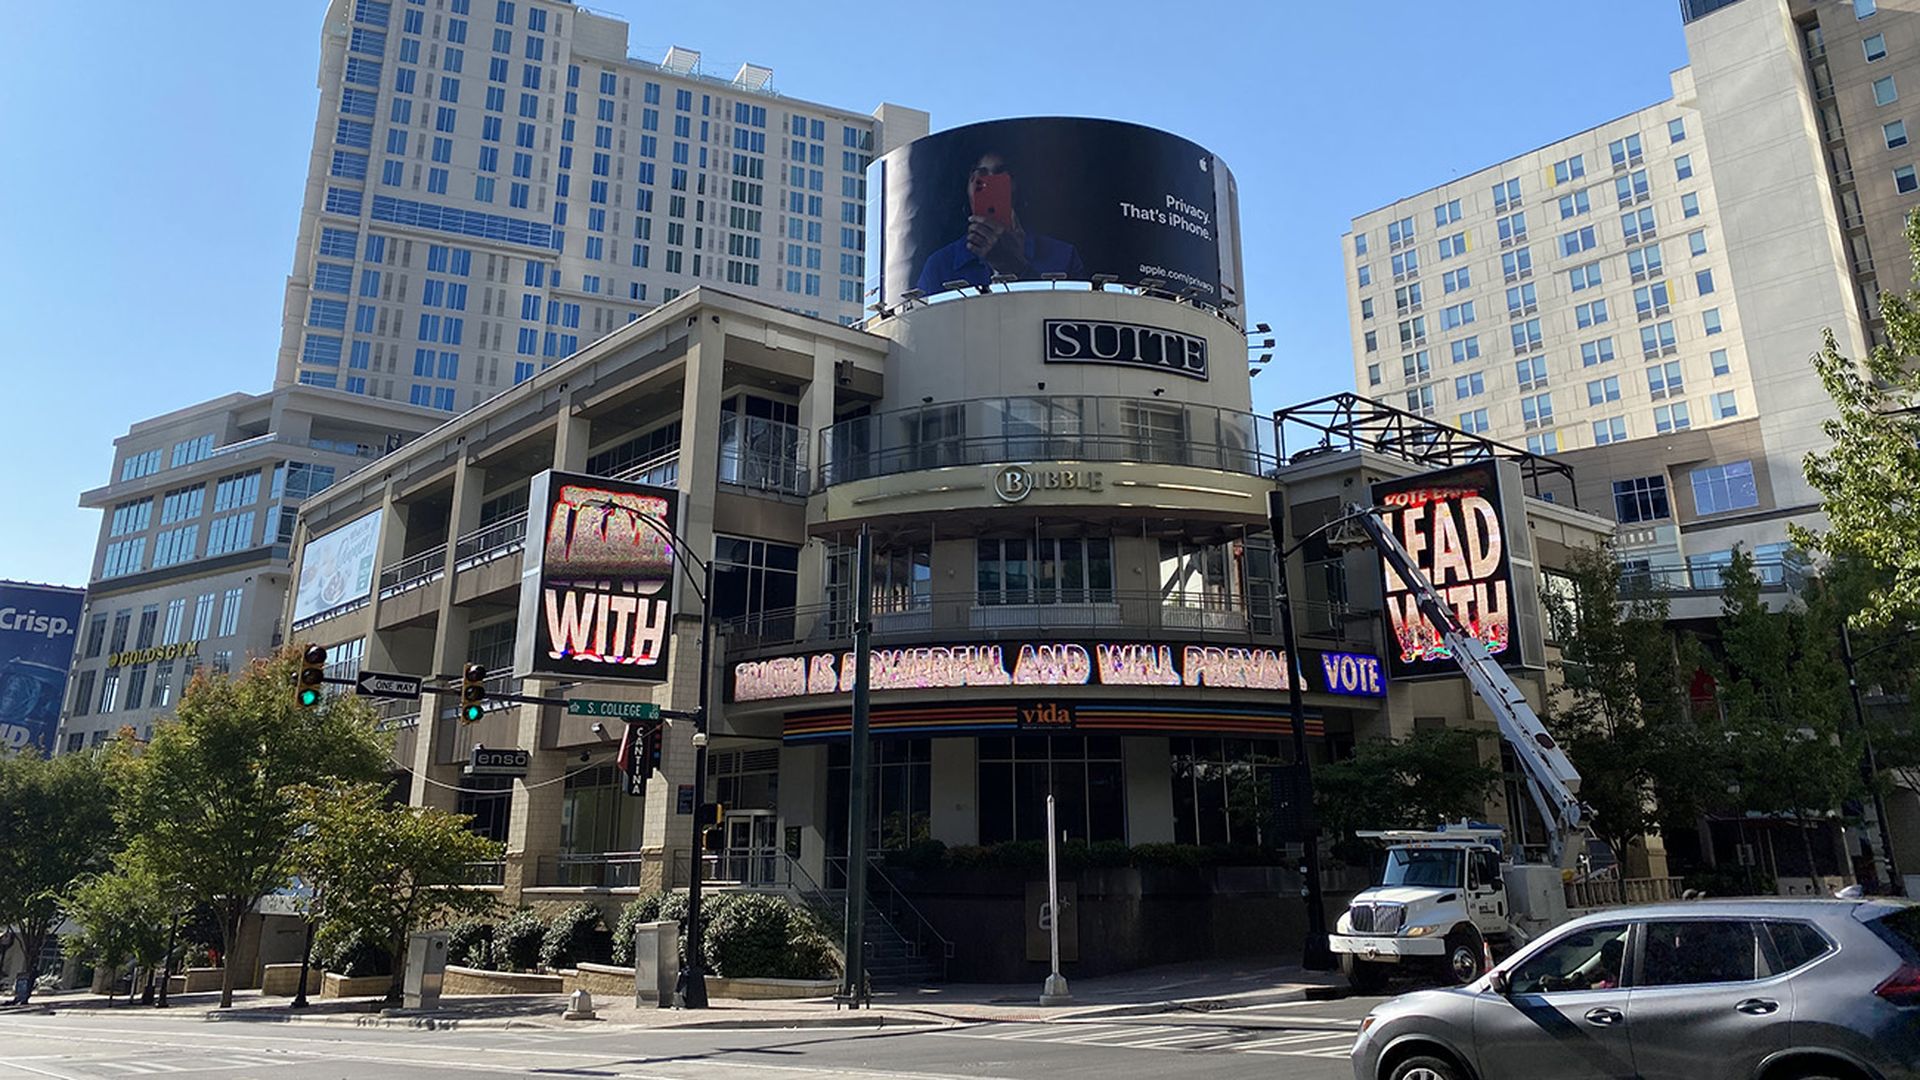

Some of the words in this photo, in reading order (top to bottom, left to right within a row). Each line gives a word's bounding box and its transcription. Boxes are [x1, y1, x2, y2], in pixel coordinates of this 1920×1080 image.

[1120, 202, 1167, 225] That's
[1168, 212, 1212, 241] iPhone.
[1165, 194, 1211, 225] Privacy.
[1139, 264, 1214, 294] apple.com/privacy
[1054, 322, 1205, 371] SUITE
[1005, 470, 1104, 494] BUBBLE
[0, 607, 74, 639] Crisp.
[544, 588, 668, 661] WITH
[1013, 644, 1091, 685] AND
[1323, 653, 1379, 692] VOTE
[375, 680, 393, 690] ONE
[397, 683, 415, 692] WAY
[587, 703, 597, 715] S.
[600, 702, 642, 717] COLLEGE
[1022, 703, 1071, 723] vida
[632, 727, 644, 794] CANTINA
